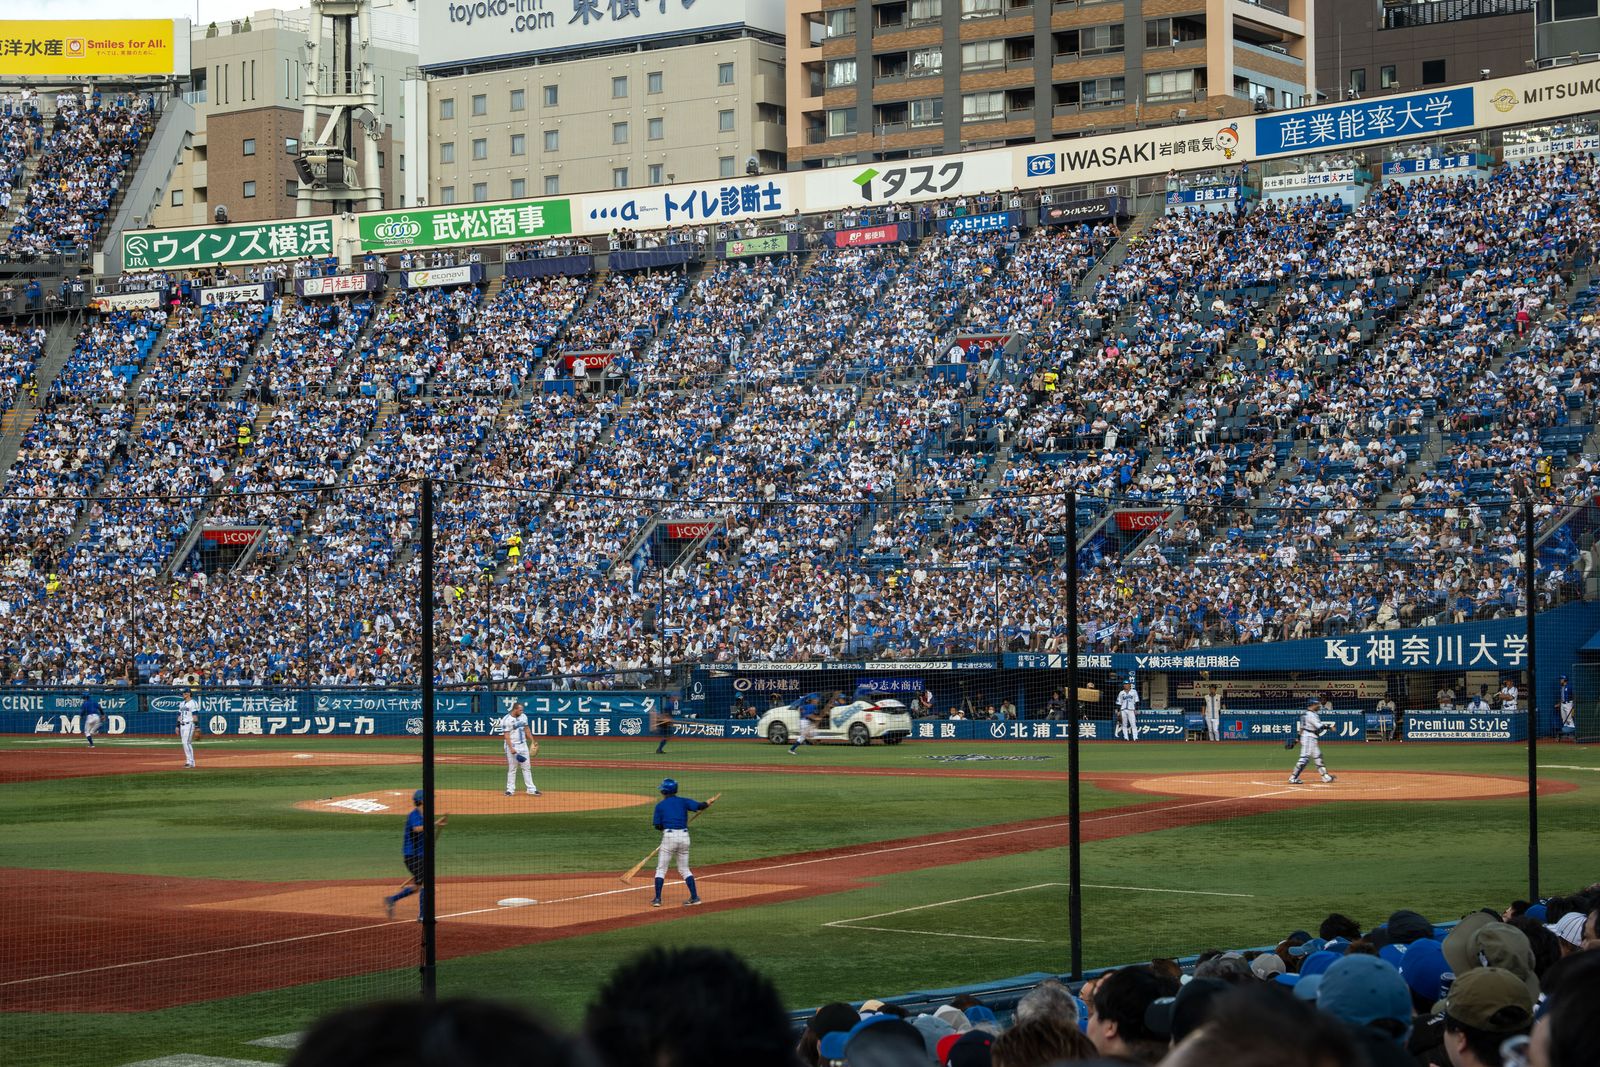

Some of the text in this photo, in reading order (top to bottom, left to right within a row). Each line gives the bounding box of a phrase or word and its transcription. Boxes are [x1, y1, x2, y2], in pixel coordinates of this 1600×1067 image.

[510, 11, 555, 33] .com
[0, 39, 63, 57] 洋水産
[87, 39, 167, 49] Smiles for All.
[1278, 94, 1453, 149] 産業能率大学
[1031, 136, 1215, 173] EYE IWASAKI 岩崎電気
[1415, 155, 1470, 172] 日総工産
[881, 161, 964, 199] タスク
[664, 181, 782, 222] トイレ診断士
[1194, 187, 1238, 201] 日総工産
[1063, 204, 1106, 216] ウィルキンソン
[432, 205, 545, 241] 武松商事
[964, 214, 1006, 229] ヒトトヒト
[153, 222, 332, 264] ウインズ横浜
[864, 230, 886, 240] 郵便局
[127, 257, 149, 267] JRA
[431, 269, 464, 280] econavi
[321, 275, 365, 293] 月桂冠
[215, 288, 259, 301] 横浜シミズ
[1366, 634, 1528, 666] 神奈川大学
[1148, 655, 1241, 668] 横浜幸銀信用組合
[754, 679, 800, 691] 清水建設
[879, 679, 922, 691] 志水商店
[1, 695, 44, 712] CERTE
[97, 697, 127, 709] セルテ
[59, 714, 127, 735] MD
[212, 715, 375, 735] oku 奥アンツーカ
[435, 717, 612, 736] 株式会社 湾山下商事
[919, 723, 956, 738] 建設
[1409, 717, 1509, 732] Premium Style
